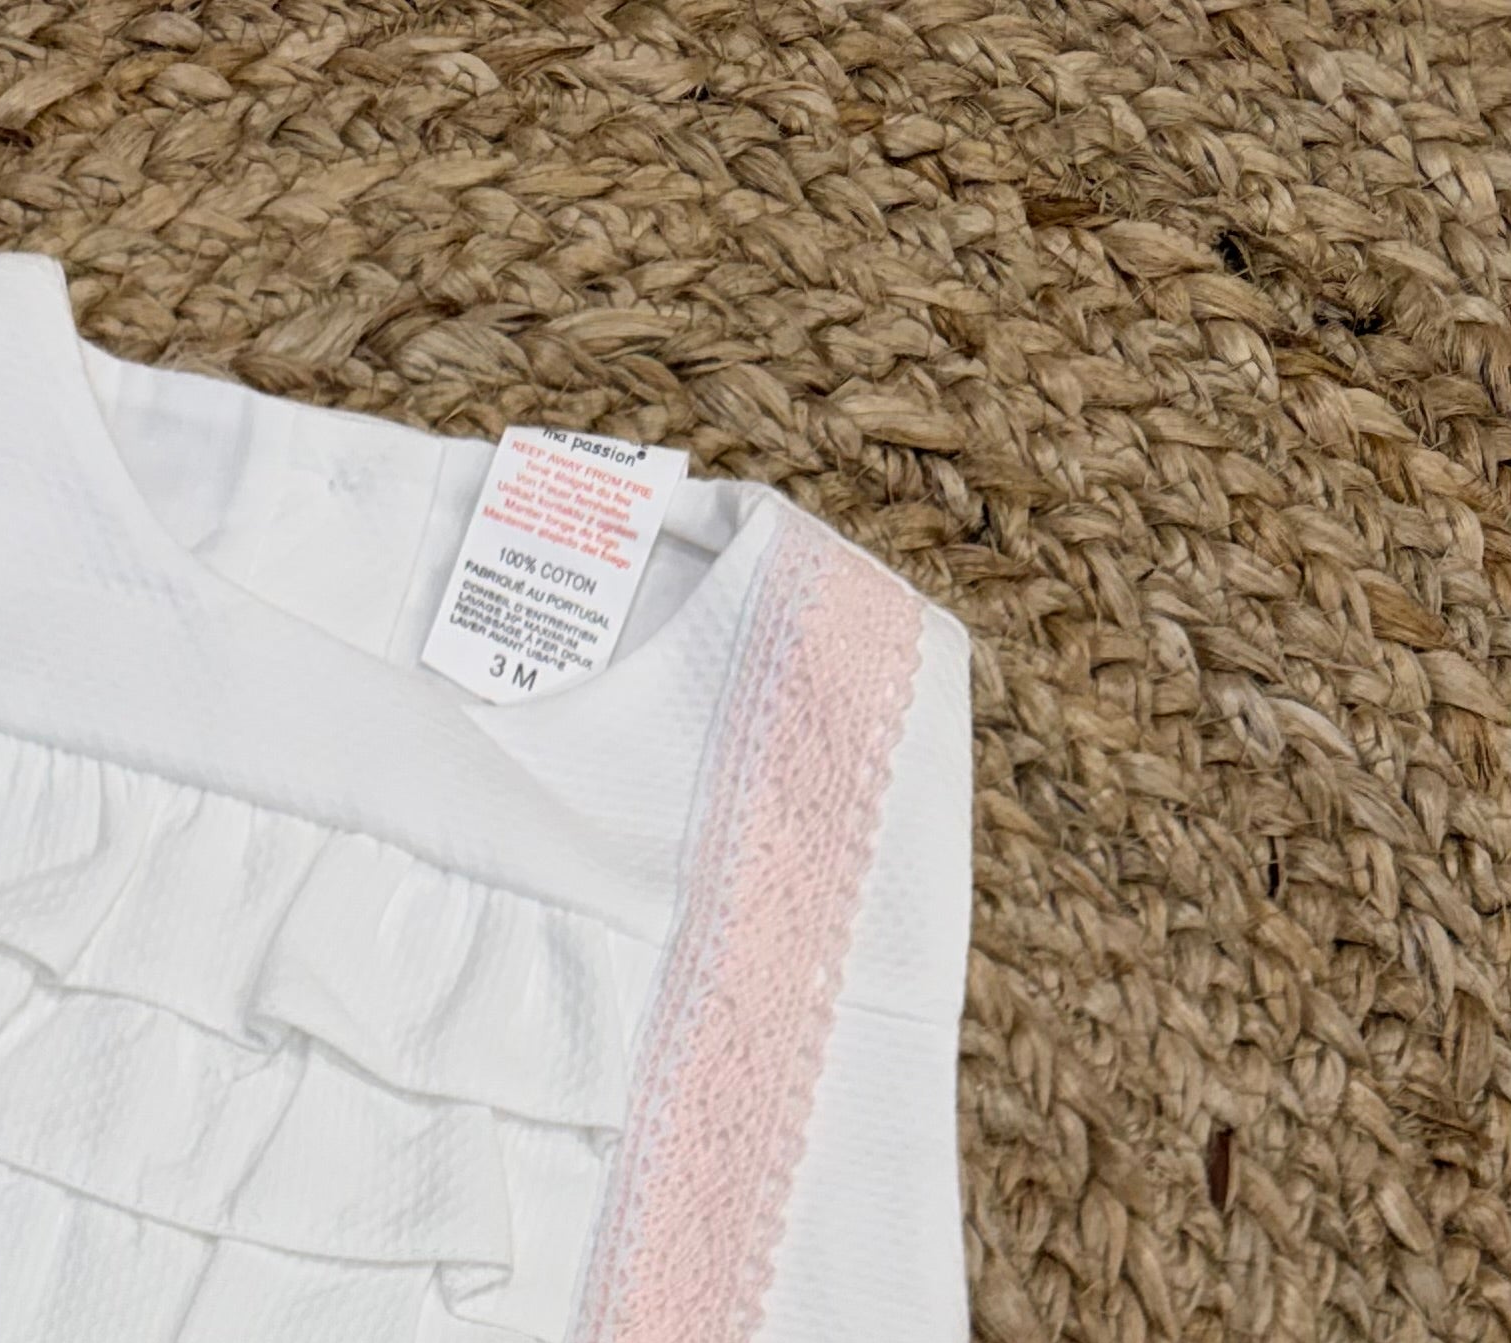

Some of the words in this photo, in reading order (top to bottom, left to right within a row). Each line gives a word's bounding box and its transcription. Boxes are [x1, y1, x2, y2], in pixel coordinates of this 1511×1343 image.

[548, 453, 583, 472] AWAY
[584, 466, 622, 486] FROM
[624, 480, 653, 499] FIRE
[499, 547, 537, 574] 100%
[540, 562, 597, 595] COTON
[462, 581, 510, 609] CONSEIL
[464, 560, 525, 594] FABRIQUÉ
[525, 588, 546, 602] AU
[546, 594, 609, 630] PORTUGAL
[449, 614, 486, 635] LAVER
[487, 630, 524, 653] AVANT
[453, 602, 522, 639] REPASSAGE
[536, 636, 559, 654] FER
[561, 649, 593, 671] DOUX
[458, 592, 502, 617] LAVAGE
[524, 621, 579, 650] MAXIMUM
[489, 654, 507, 677] 3
[512, 663, 538, 691] M
